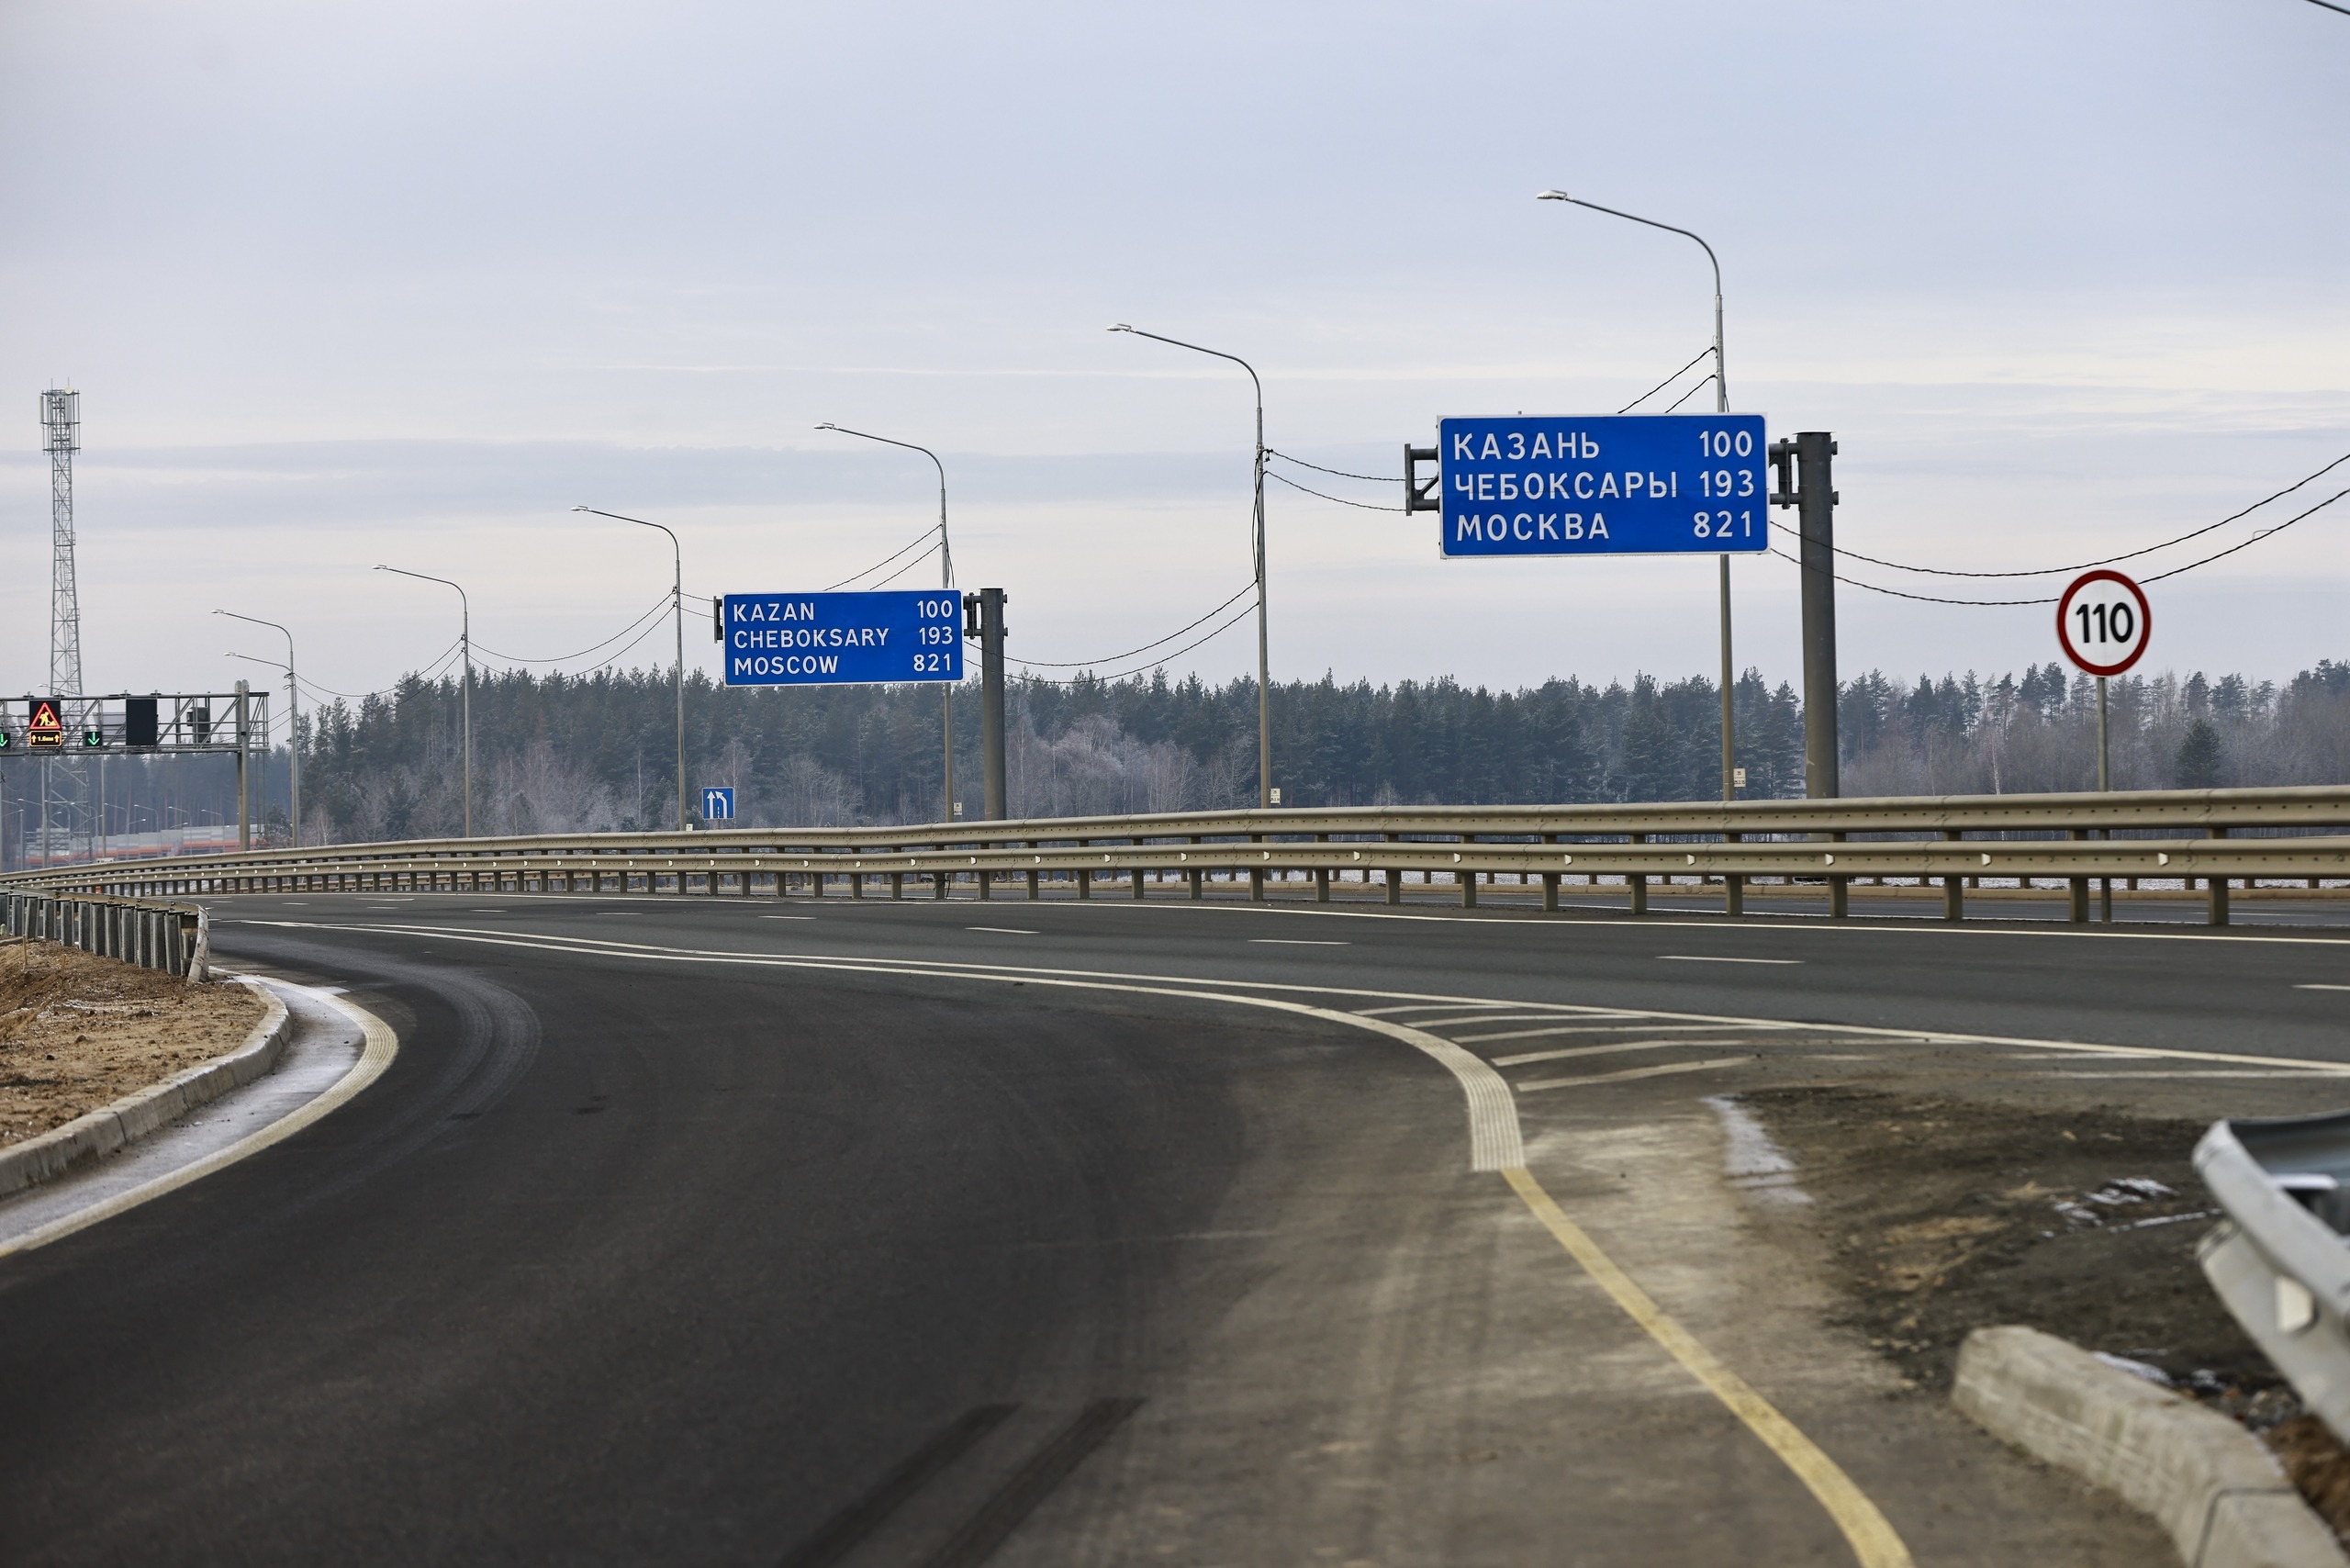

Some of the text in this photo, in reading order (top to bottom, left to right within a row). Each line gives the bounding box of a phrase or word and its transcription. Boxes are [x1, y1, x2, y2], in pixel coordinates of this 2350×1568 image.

[1454, 431, 1752, 460] КАЗАНЬ 100
[1455, 469, 1754, 500] ЧЕБОКСАРЫ 193
[1457, 510, 1751, 542] МОСКВА 821
[733, 599, 953, 622] KAZAN 100
[2076, 602, 2133, 644] 110
[734, 626, 953, 649] CHEBOKSARY 193
[734, 653, 951, 676] MOSCOW 821
